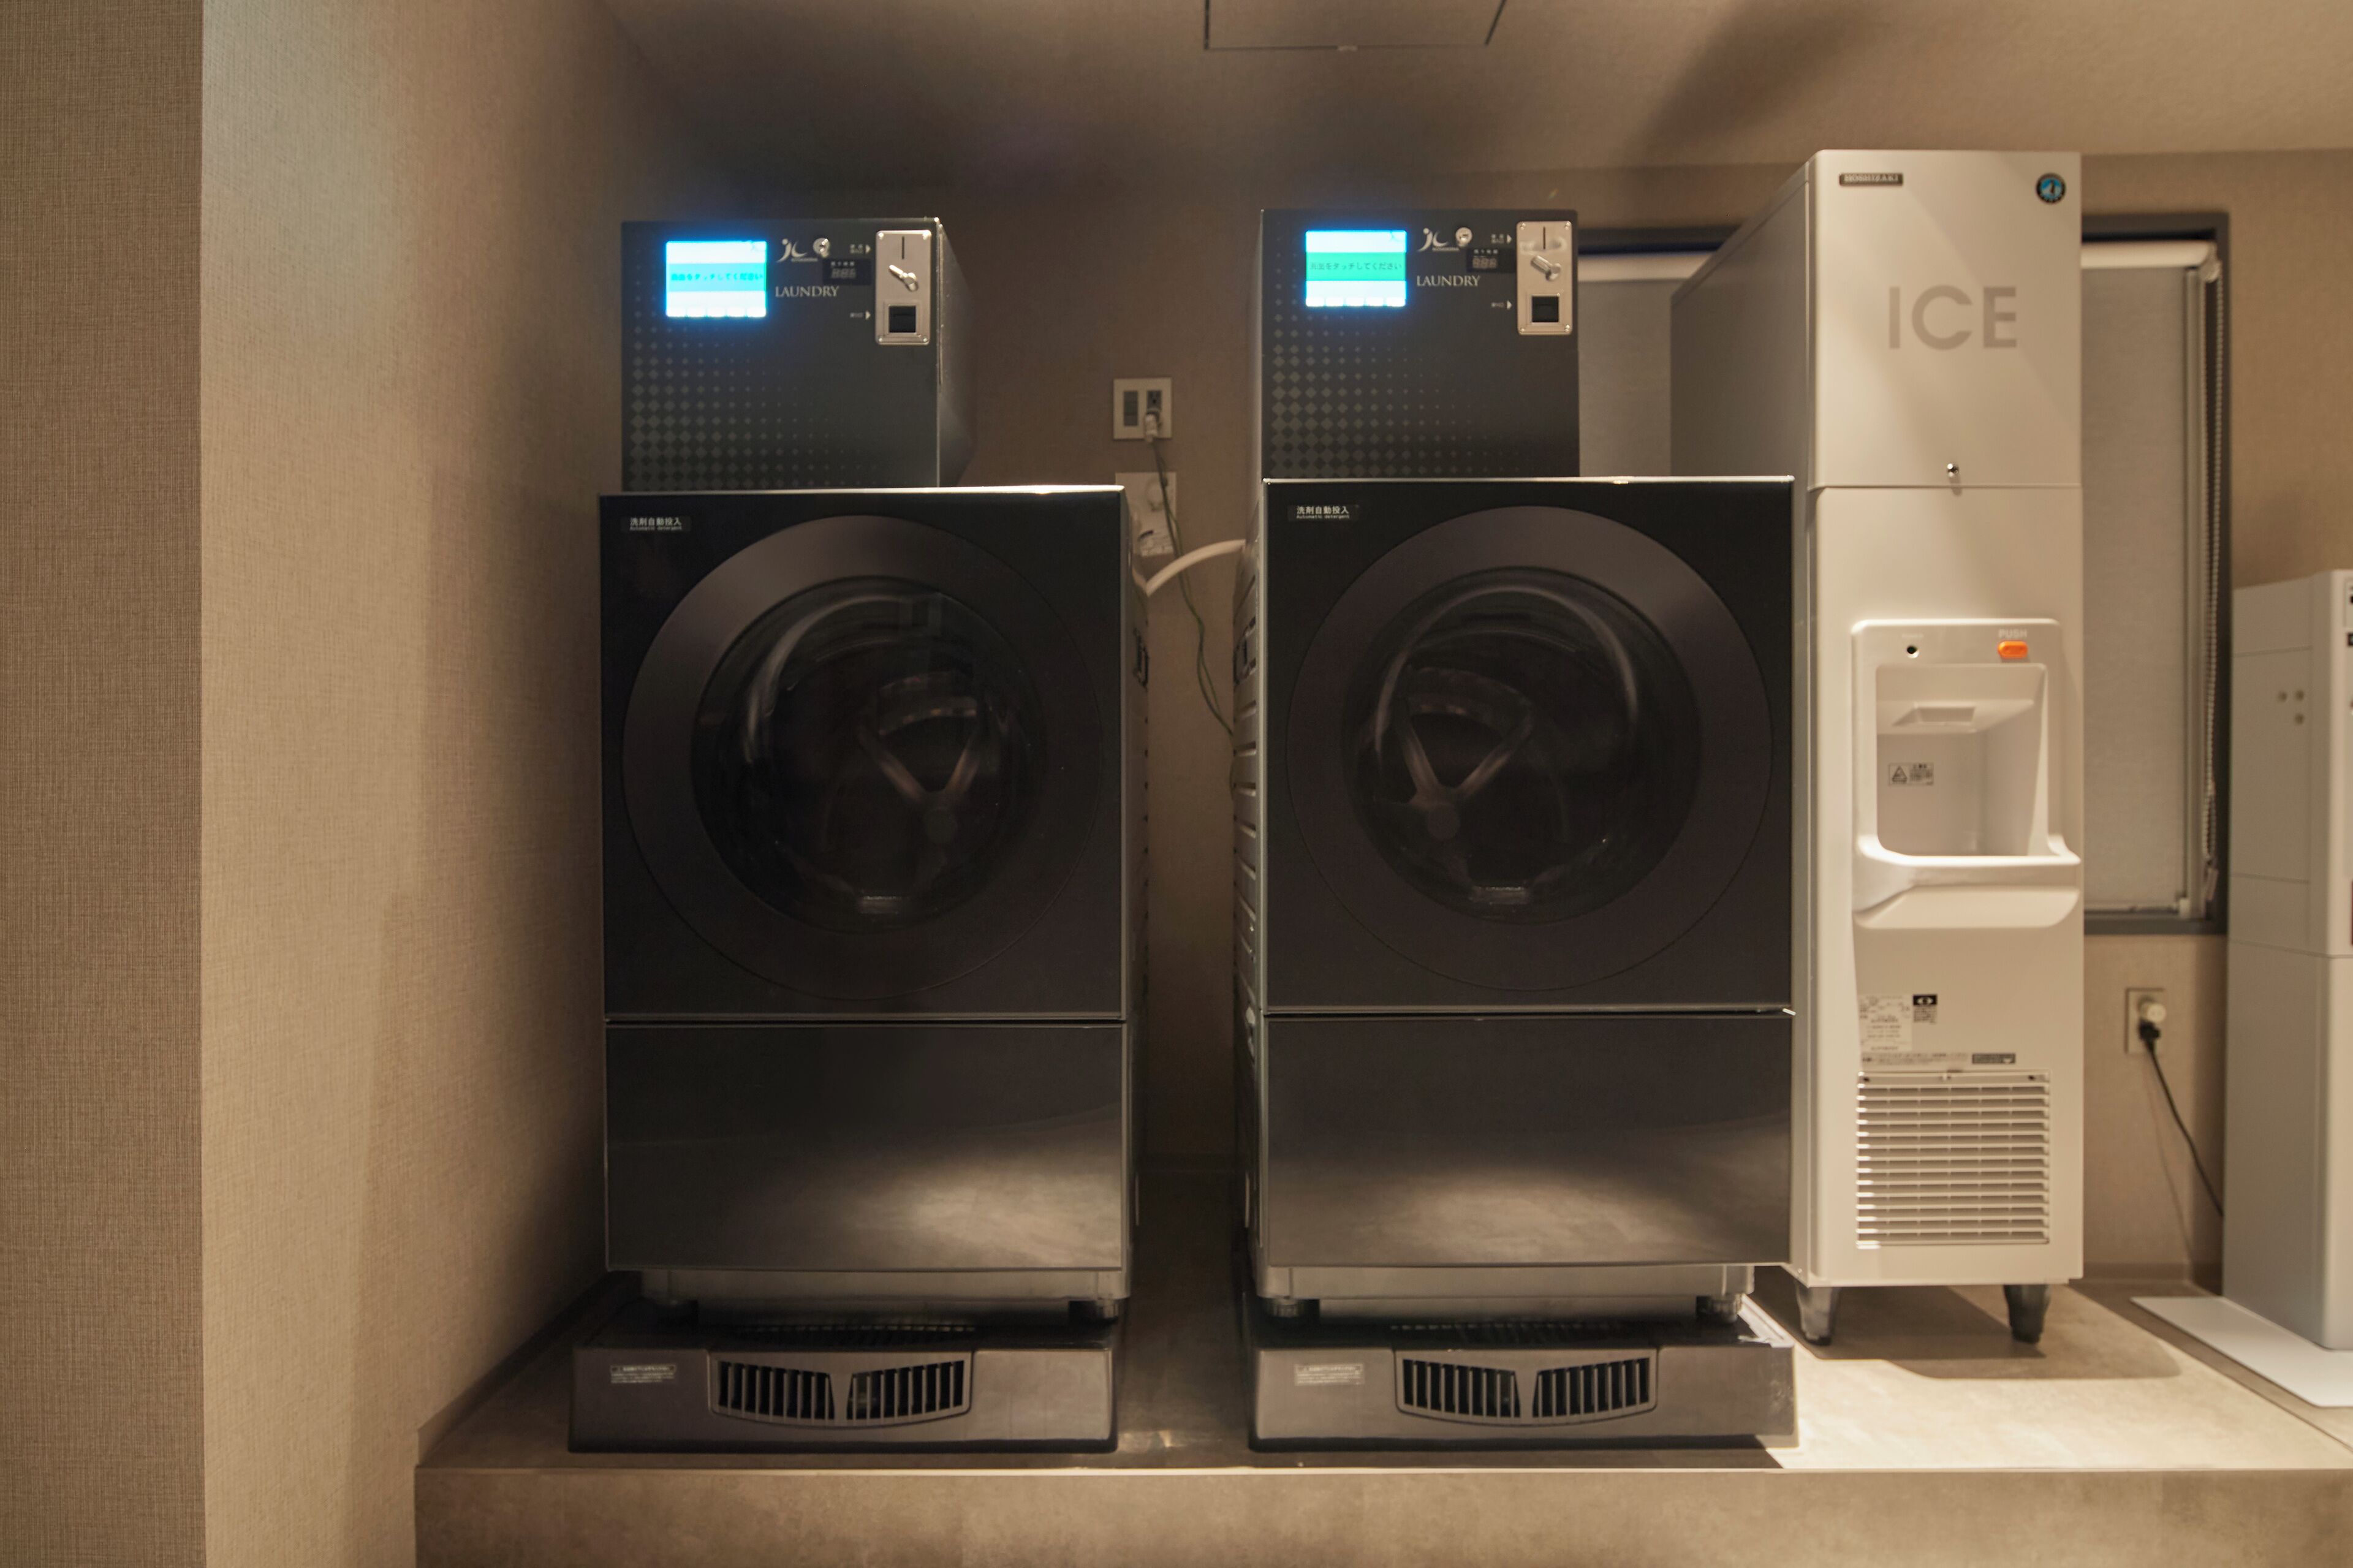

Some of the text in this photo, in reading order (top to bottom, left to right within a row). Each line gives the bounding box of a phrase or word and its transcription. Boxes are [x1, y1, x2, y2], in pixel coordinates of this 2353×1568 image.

[1416, 275, 1481, 287] LAUNDRY
[775, 286, 839, 298] LAUNDRY
[1889, 284, 2017, 350] ICE
[1297, 506, 1349, 515] 洗剤自動投入
[1998, 629, 2027, 638] PUSH
